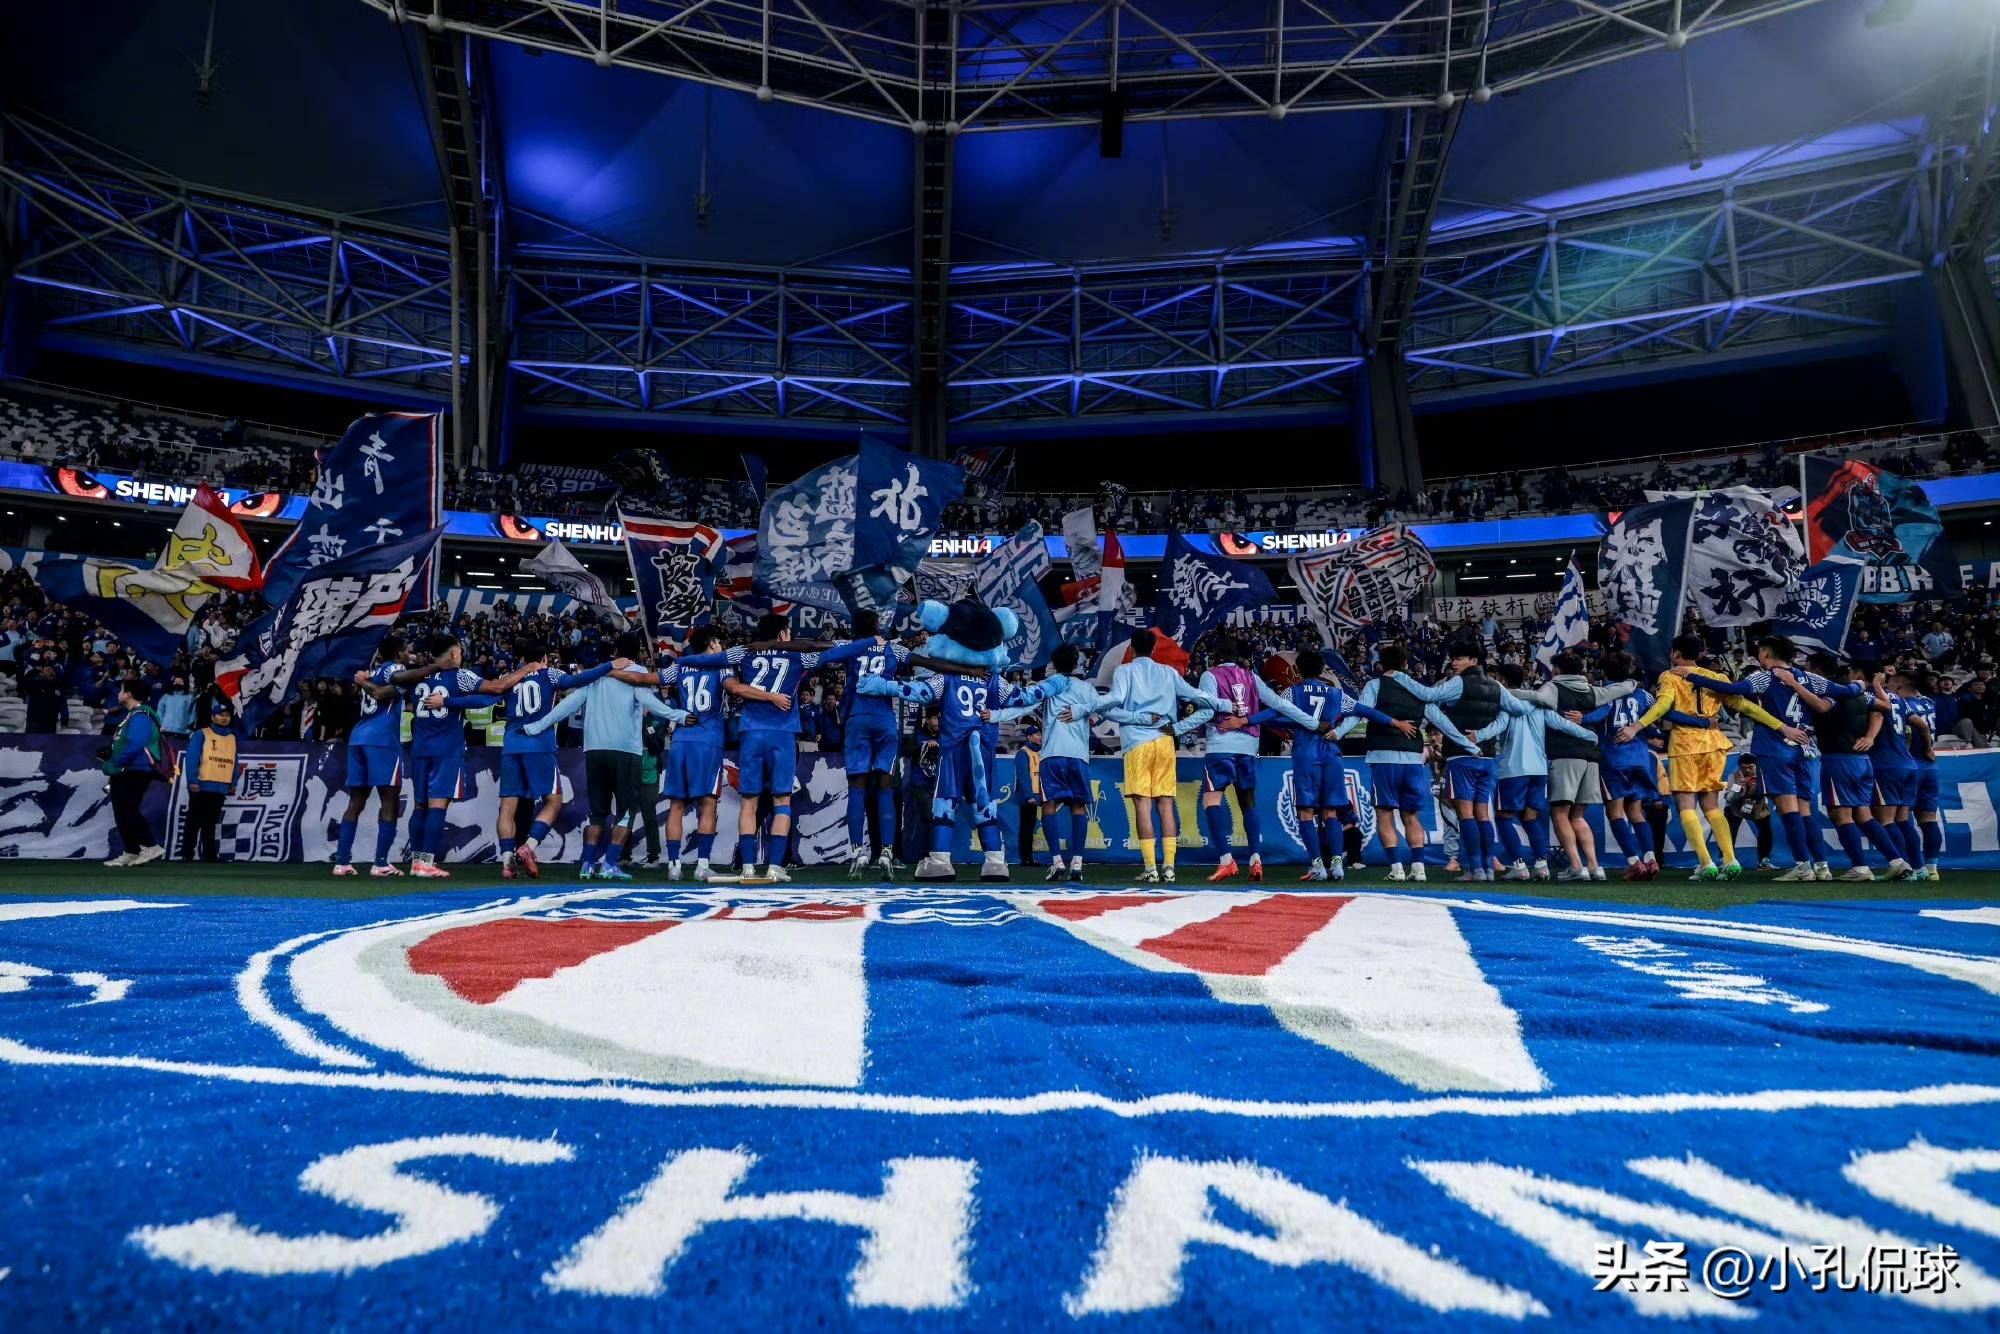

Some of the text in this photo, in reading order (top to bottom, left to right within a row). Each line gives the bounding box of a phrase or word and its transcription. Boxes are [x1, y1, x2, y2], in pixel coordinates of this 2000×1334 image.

[116, 480, 229, 508] SHENH
[545, 522, 624, 541] SHENHU
[927, 539, 992, 553] ENHUA
[1262, 533, 1352, 550] SHENHUA
[1437, 597, 1529, 618] 申花铁杆
[752, 656, 790, 694] 27
[512, 680, 542, 718] 10
[682, 674, 712, 713] 16
[957, 685, 988, 717] 93
[1309, 695, 1326, 722] 7
[1785, 692, 1803, 723] 4
[241, 766, 277, 798] 魔
[259, 803, 289, 858] DEVIL
